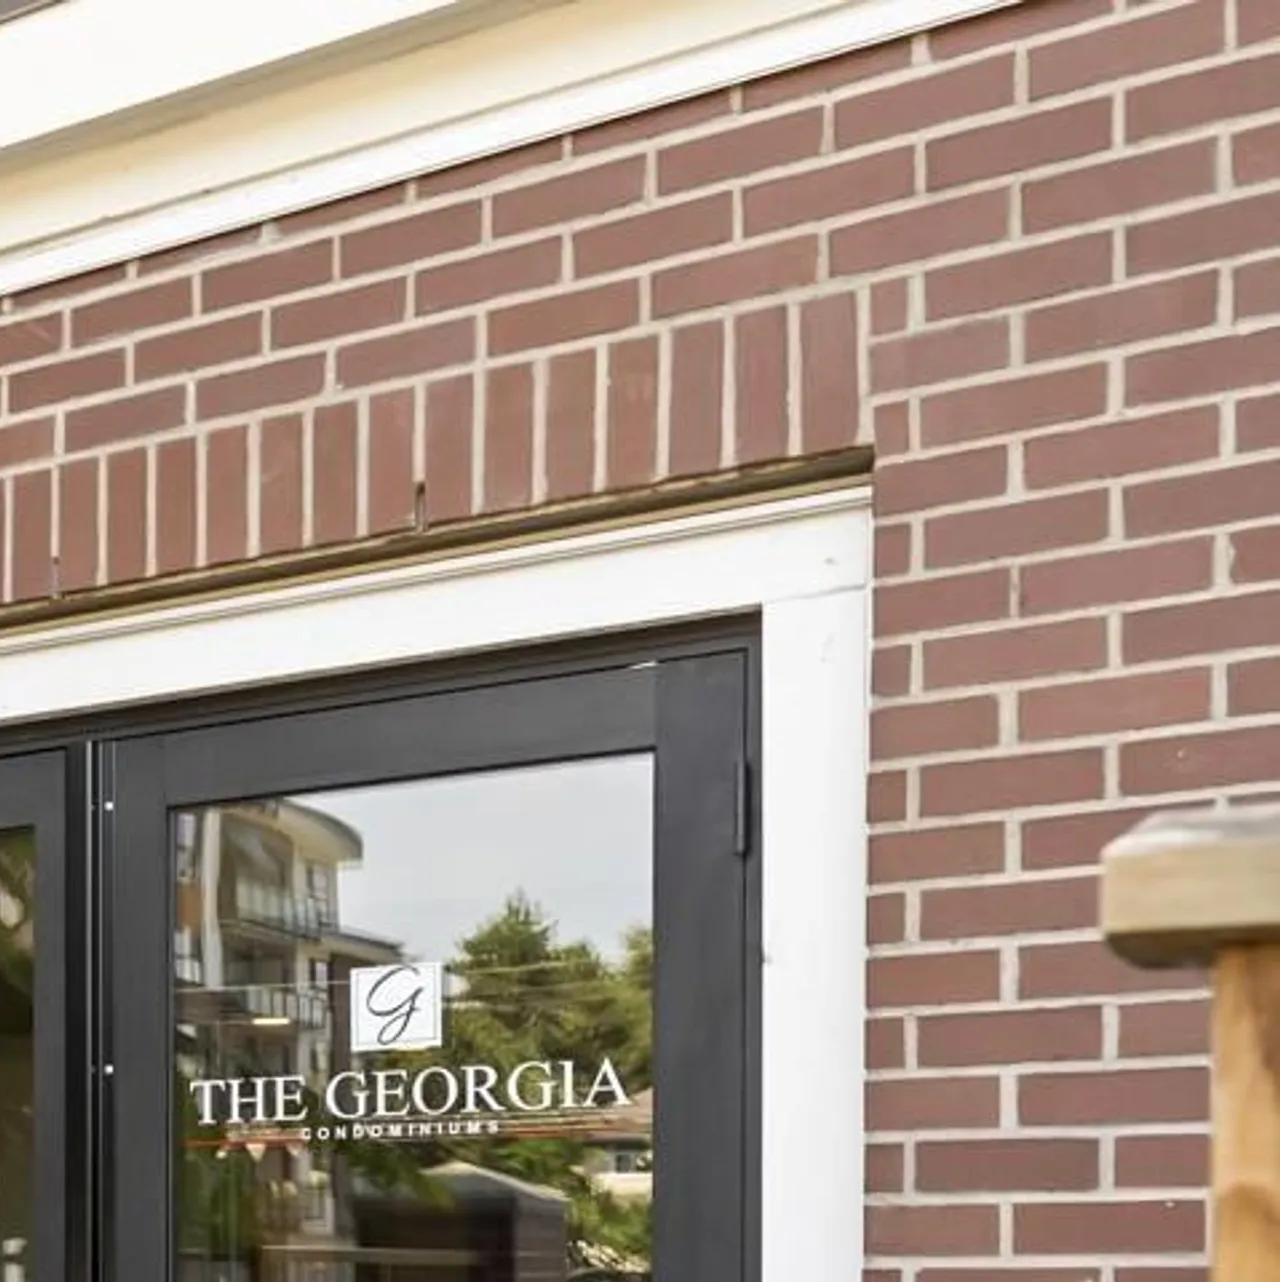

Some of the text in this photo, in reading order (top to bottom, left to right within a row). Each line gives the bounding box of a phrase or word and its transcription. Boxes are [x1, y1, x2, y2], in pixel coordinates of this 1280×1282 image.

[190, 1056, 632, 1125] THE GEORGIA
[301, 1120, 499, 1140] CONDOMINIUMS
